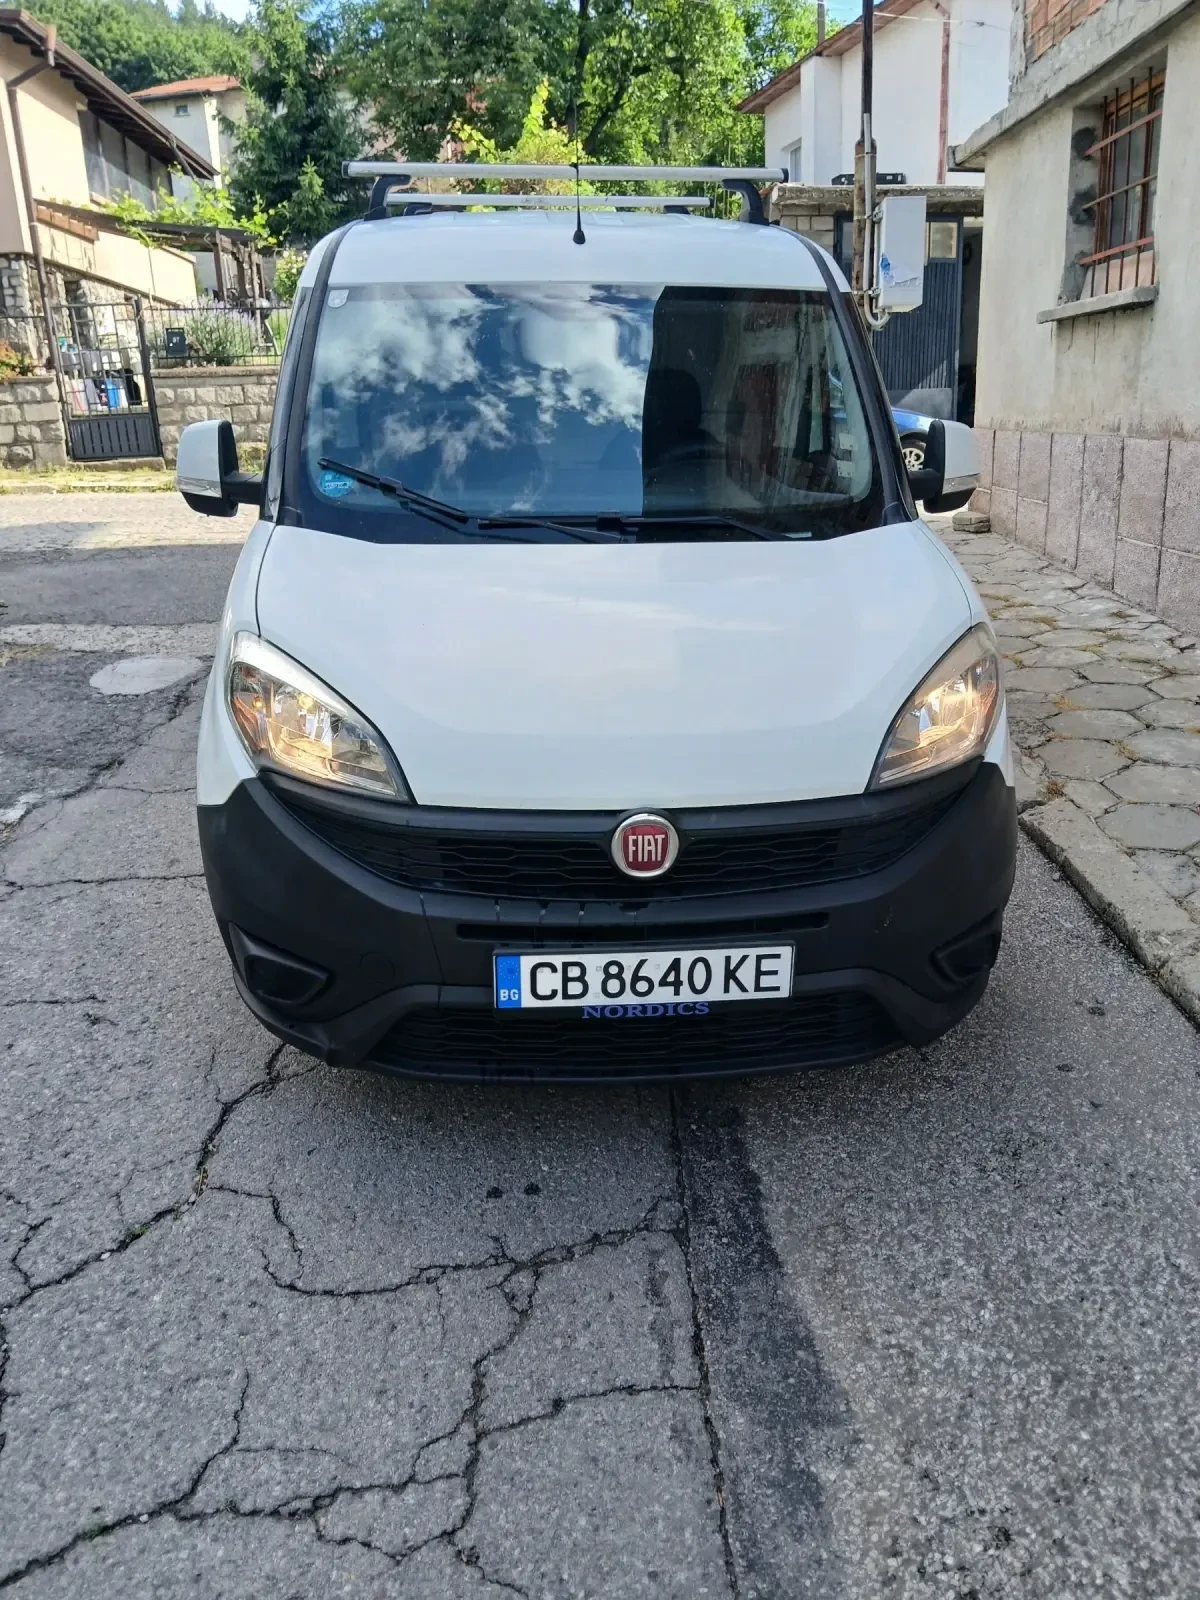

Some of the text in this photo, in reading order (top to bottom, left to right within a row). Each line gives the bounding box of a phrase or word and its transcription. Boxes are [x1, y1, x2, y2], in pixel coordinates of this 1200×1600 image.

[628, 834, 666, 862] FIAT
[529, 953, 782, 1000] CB 8640 KE
[500, 989, 519, 1001] BG
[581, 1001, 710, 1019] NORDICS
